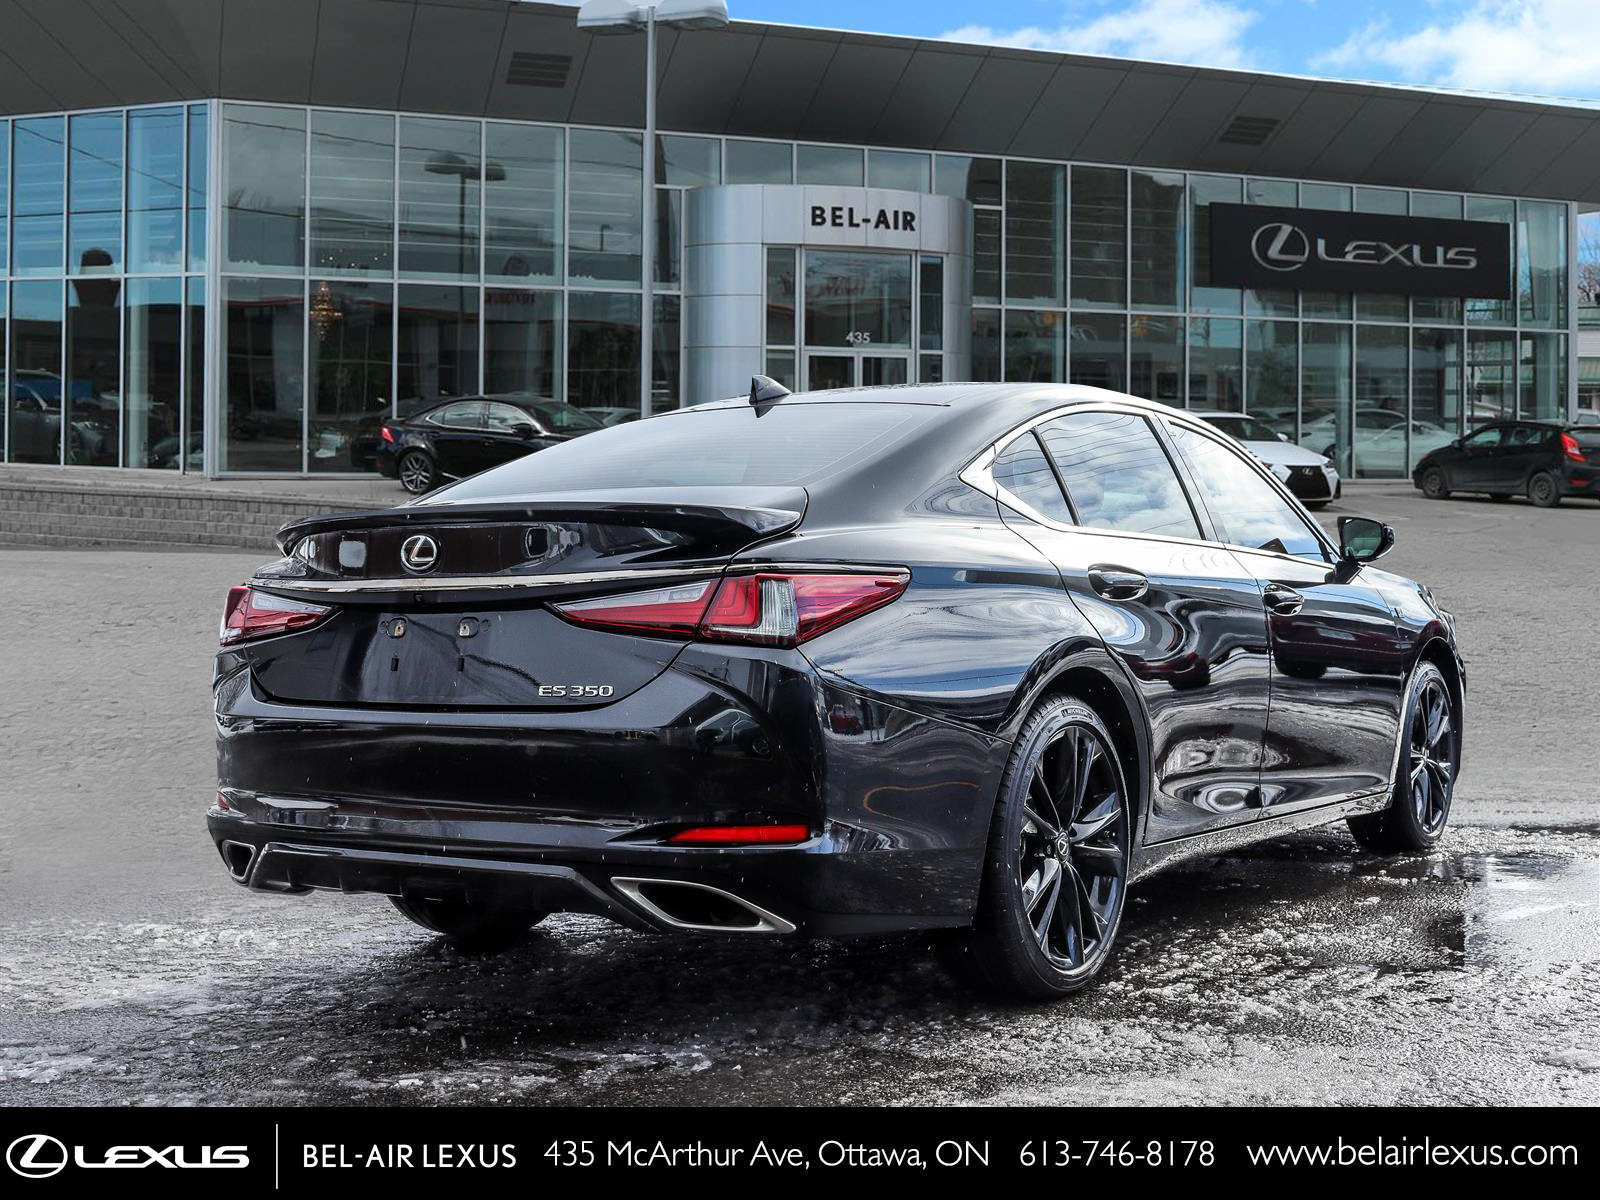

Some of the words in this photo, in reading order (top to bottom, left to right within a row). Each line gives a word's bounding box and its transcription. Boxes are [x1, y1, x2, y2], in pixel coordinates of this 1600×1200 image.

[811, 206, 916, 231] BEL-AIR
[1317, 238, 1477, 269] LEXUS
[846, 331, 870, 344] 435
[538, 685, 567, 697] ES
[569, 685, 614, 697] 350
